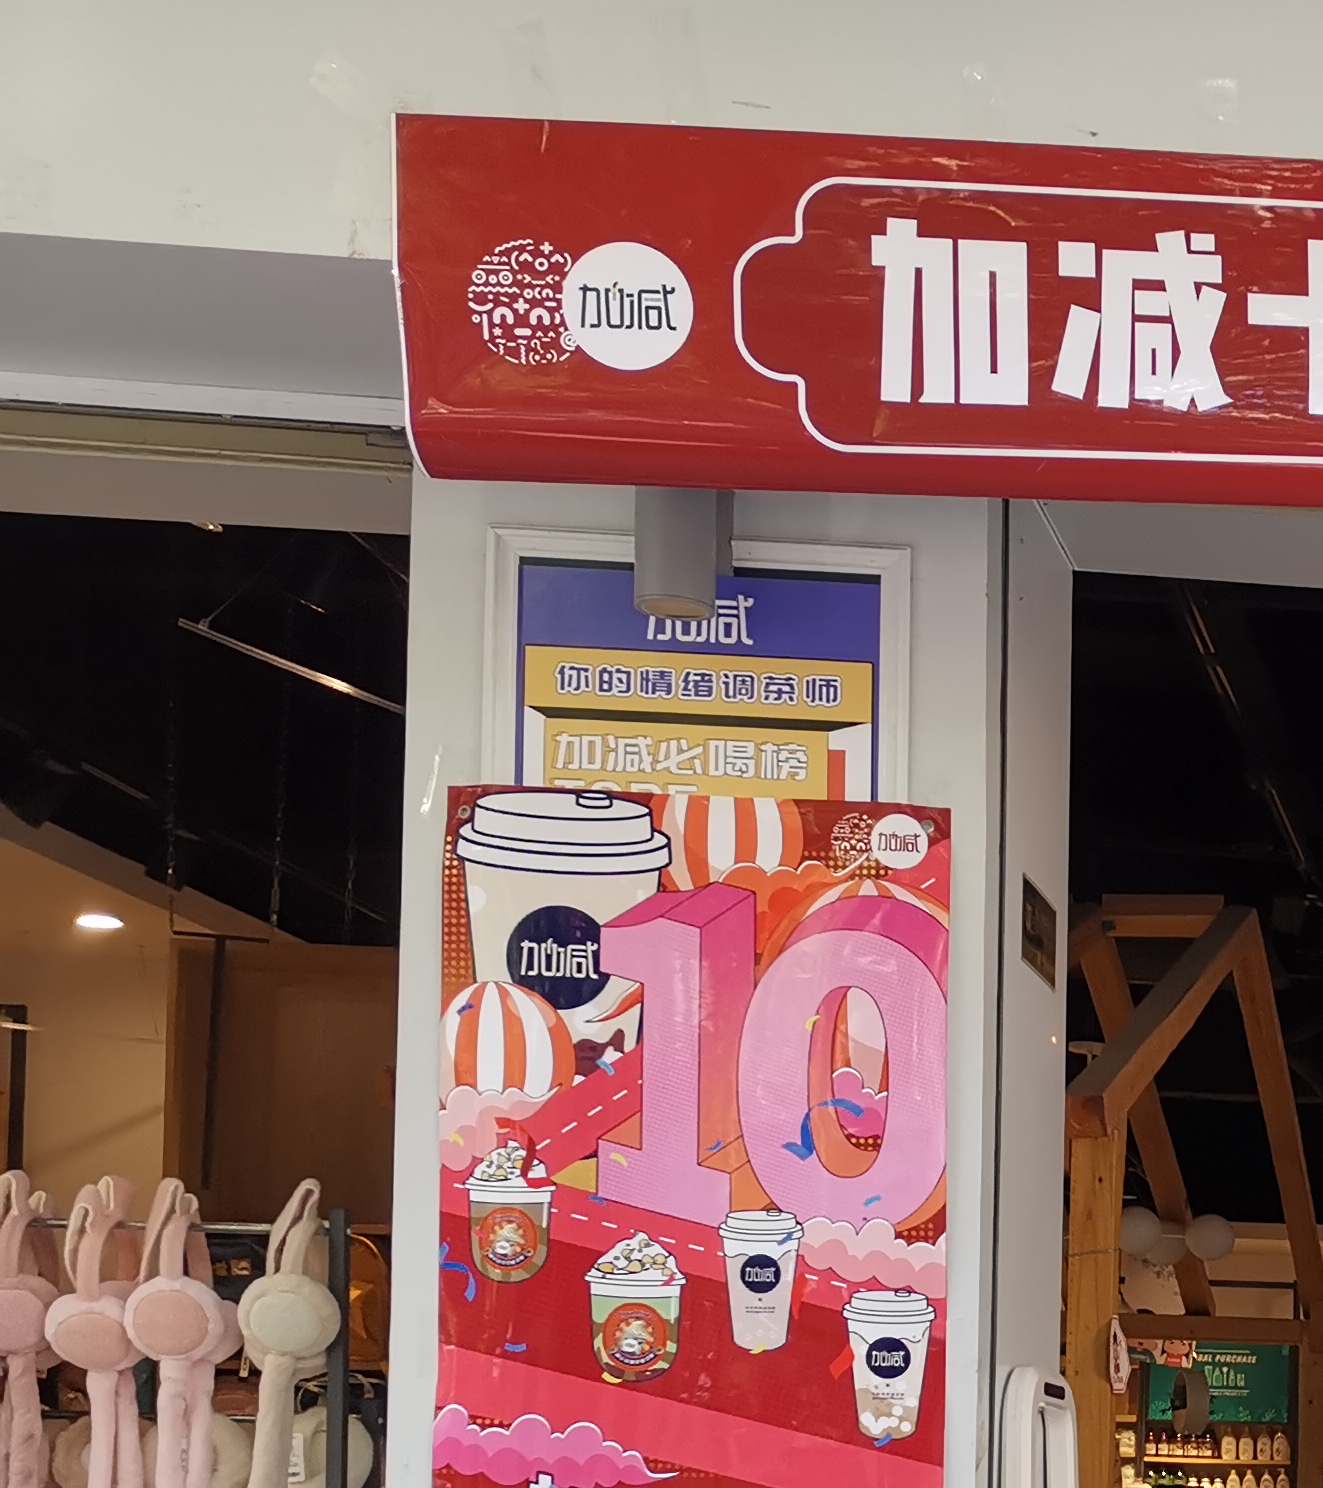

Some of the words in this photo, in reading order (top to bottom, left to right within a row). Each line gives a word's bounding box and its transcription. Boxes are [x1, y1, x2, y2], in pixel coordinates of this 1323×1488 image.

[577, 281, 678, 333] 加减
[554, 661, 842, 708] 你的情绪调茶师
[552, 731, 809, 781] 加减必喝榜
[877, 830, 922, 854] 加减
[520, 938, 599, 980] 加减
[596, 881, 948, 1227] 10
